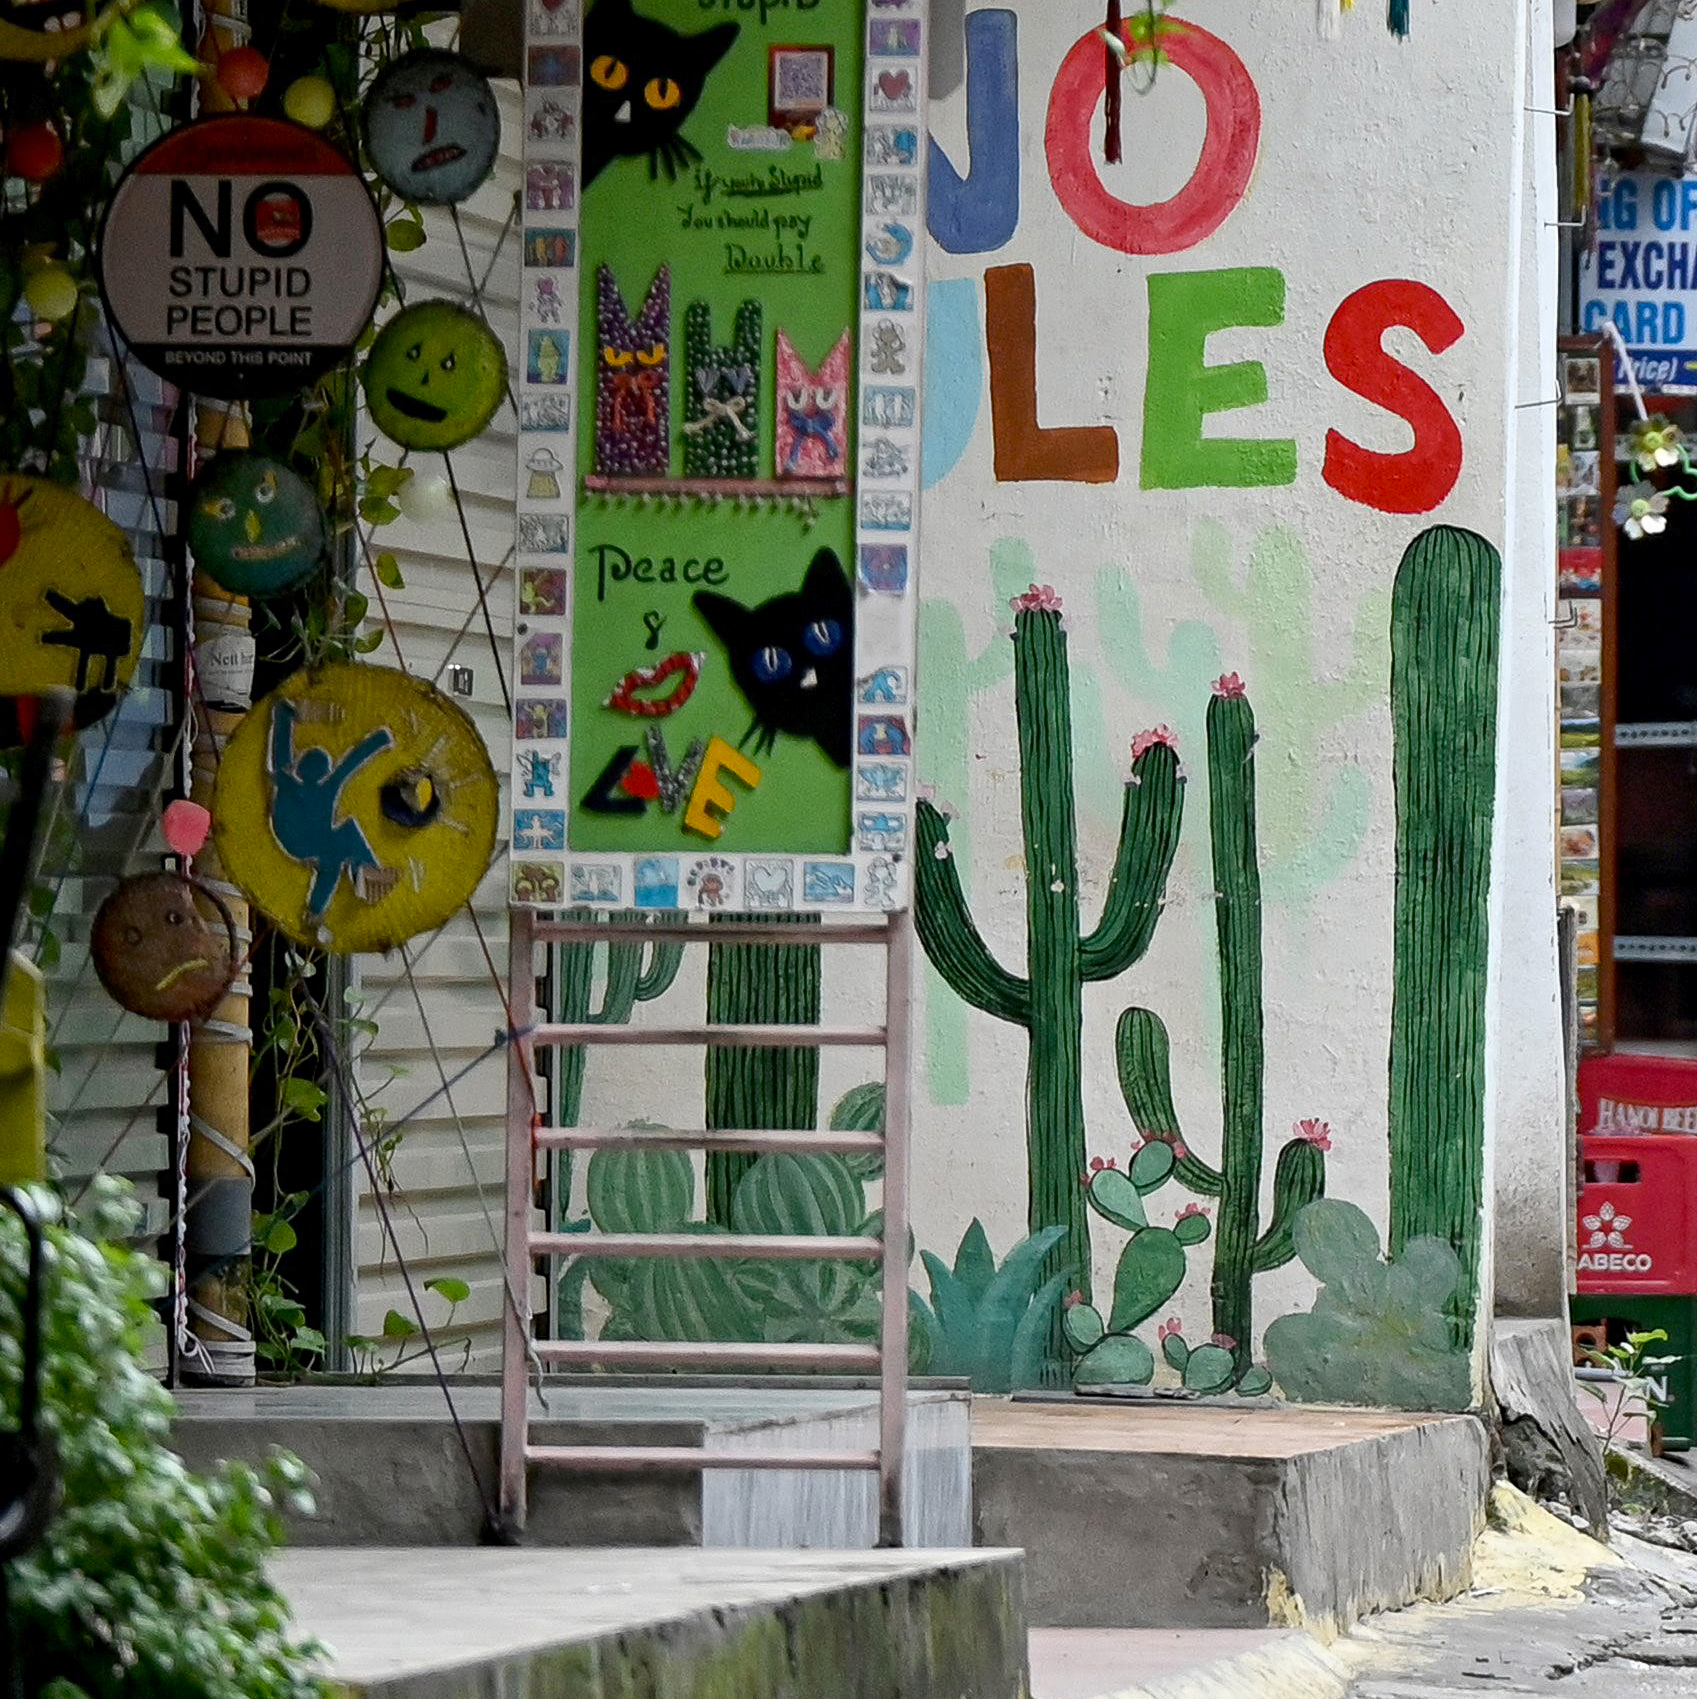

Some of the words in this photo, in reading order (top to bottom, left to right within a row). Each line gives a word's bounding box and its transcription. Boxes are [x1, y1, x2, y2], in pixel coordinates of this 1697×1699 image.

[169, 179, 313, 258] NO
[168, 266, 311, 299] STUPID
[166, 304, 312, 337] PEOPLE
[1584, 299, 1685, 345] CARD
[165, 351, 226, 365] BEYOND
[231, 351, 264, 365] THIS
[267, 351, 312, 365] POINT
[1597, 1097, 1659, 1131] HANOI
[1577, 1252, 1653, 1272] ABECO
